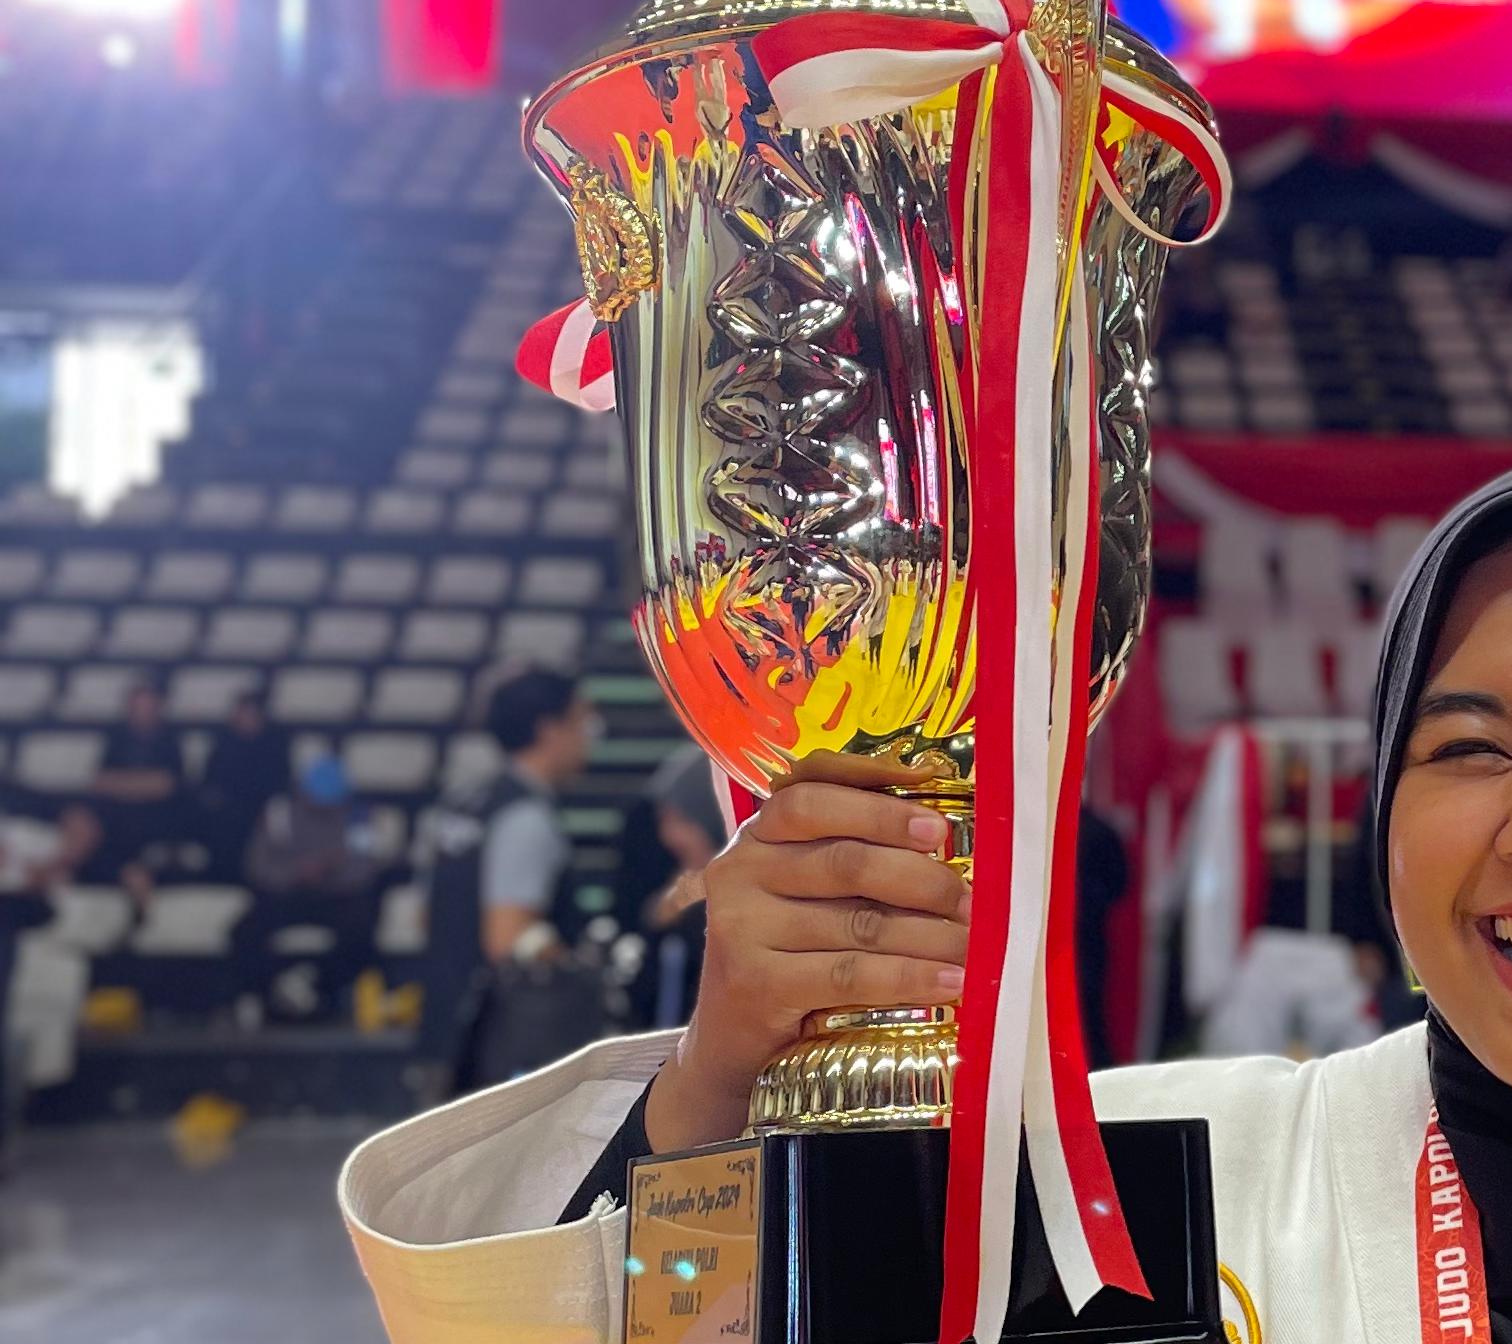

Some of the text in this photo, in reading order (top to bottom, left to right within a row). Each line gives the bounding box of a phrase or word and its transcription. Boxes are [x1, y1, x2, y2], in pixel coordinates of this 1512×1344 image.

[698, 1186, 715, 1218] Cup
[714, 1183, 740, 1210] 2024
[1434, 1245, 1474, 1338] JUDO
